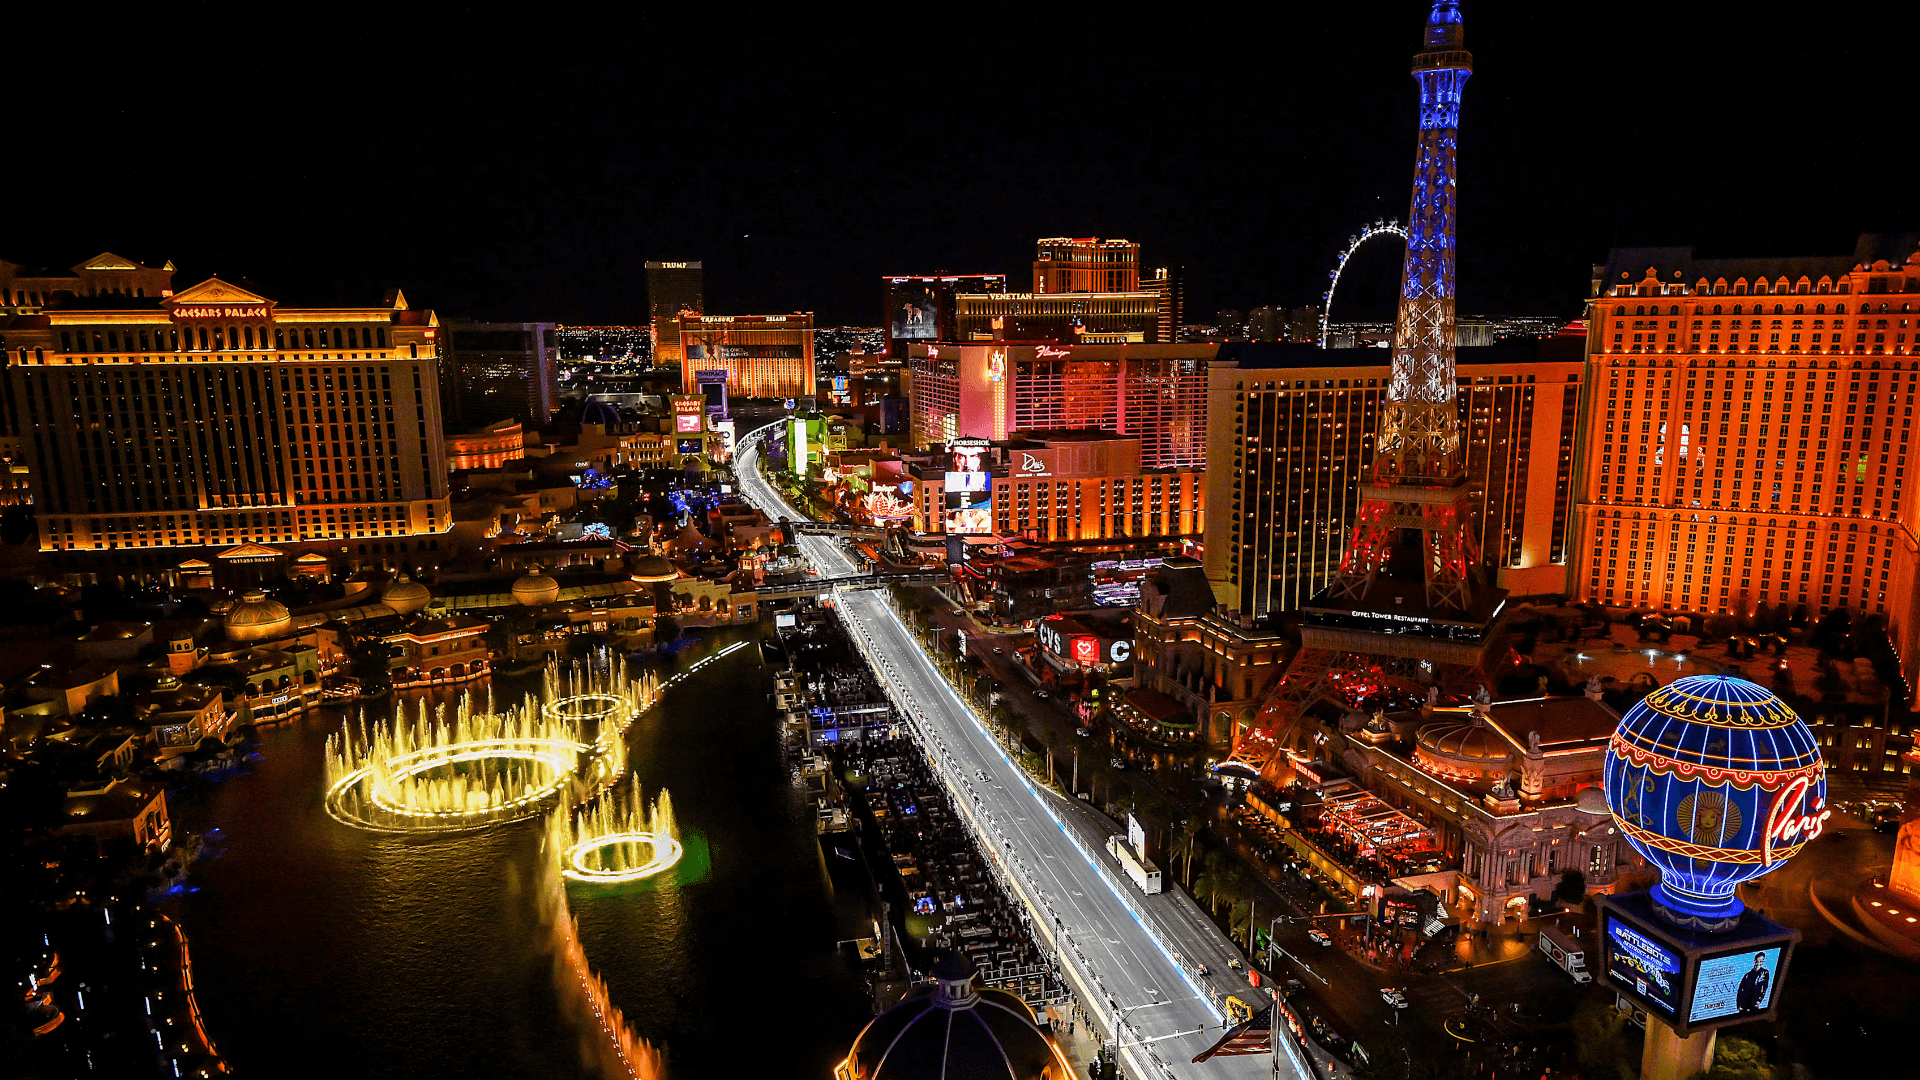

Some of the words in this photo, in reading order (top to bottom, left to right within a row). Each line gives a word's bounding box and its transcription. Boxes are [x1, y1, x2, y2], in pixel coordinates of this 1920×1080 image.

[173, 308, 222, 318] CAESARS
[224, 308, 268, 318] PALACE
[1035, 345, 1070, 359] Flamingo
[1371, 612, 1392, 620] TOWER
[1393, 614, 1429, 623] RESTAURANT
[1040, 622, 1062, 655] CVS
[1762, 776, 1831, 867] Paris
[1615, 927, 1672, 966] BATTLEBOTS
